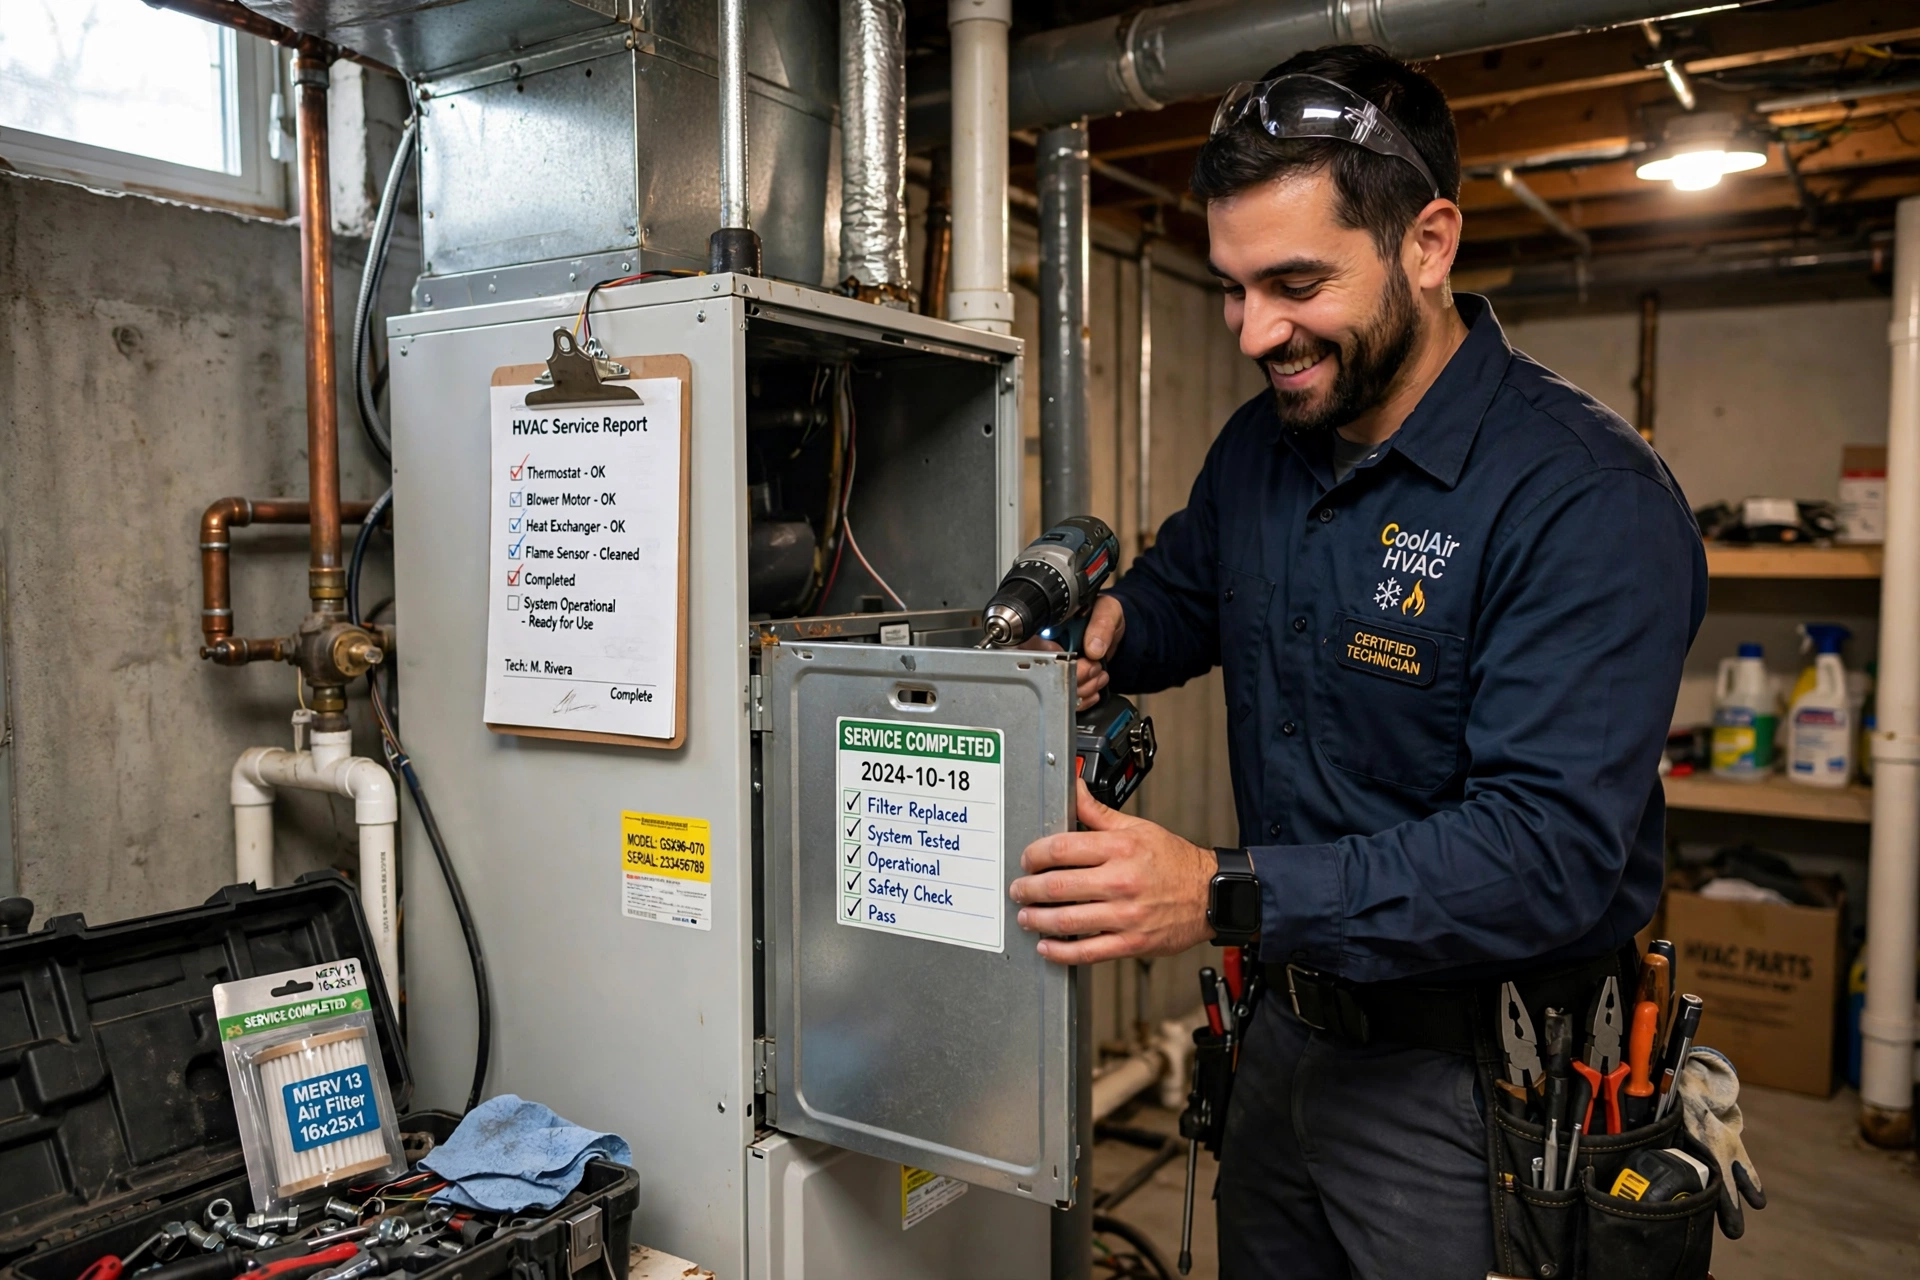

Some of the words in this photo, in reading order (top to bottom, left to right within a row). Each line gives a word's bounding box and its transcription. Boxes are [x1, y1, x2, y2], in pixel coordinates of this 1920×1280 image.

[513, 419, 548, 435] HVAC
[552, 417, 600, 434] Service
[603, 417, 648, 437] Report
[527, 466, 581, 479] Thermostat
[590, 465, 606, 478] OK
[527, 493, 559, 506] Blower
[562, 493, 591, 506] Motor
[600, 492, 616, 506] OK
[526, 519, 548, 532] Heat
[550, 519, 601, 536] Exchanger
[610, 520, 626, 533] OK
[1381, 522, 1460, 558] CoolAir
[526, 546, 554, 559] Flame
[557, 547, 590, 559] Sensor
[600, 546, 640, 560] Cleaned
[1382, 548, 1446, 579] HVAC
[525, 572, 576, 589] Completed
[524, 596, 558, 614] System
[560, 597, 616, 614] Operational
[529, 614, 557, 632] Ready
[560, 615, 574, 629] for
[576, 616, 594, 630] Use
[1354, 631, 1417, 658] CERTIFIED
[505, 659, 528, 672] Tech:
[530, 660, 541, 673] M.
[544, 660, 572, 675] Rivera
[1346, 644, 1421, 676] TECHNICIAN
[610, 687, 653, 704] Complete
[844, 726, 902, 750] SERVICE
[906, 732, 995, 758] COMPLETED
[861, 761, 970, 791] 2024-10-18
[868, 797, 903, 816] Filter
[909, 801, 967, 824] Replaced
[627, 833, 657, 849] MODEL:
[868, 825, 912, 846] System
[918, 830, 960, 851] Tested
[627, 850, 658, 867] SERIAL:
[868, 852, 940, 876] Operational
[868, 878, 908, 904] Safety
[913, 885, 953, 906] Check
[868, 904, 896, 924] Pass
[1745, 947, 1812, 981] PARTS
[244, 1011, 288, 1029] SERVICE
[288, 998, 347, 1020] COMPLETED
[292, 1076, 341, 1104] MERV
[345, 1072, 363, 1089] 13
[298, 1103, 321, 1123] Air
[326, 1093, 366, 1115] Filter
[300, 1112, 365, 1143] 16x25x1
